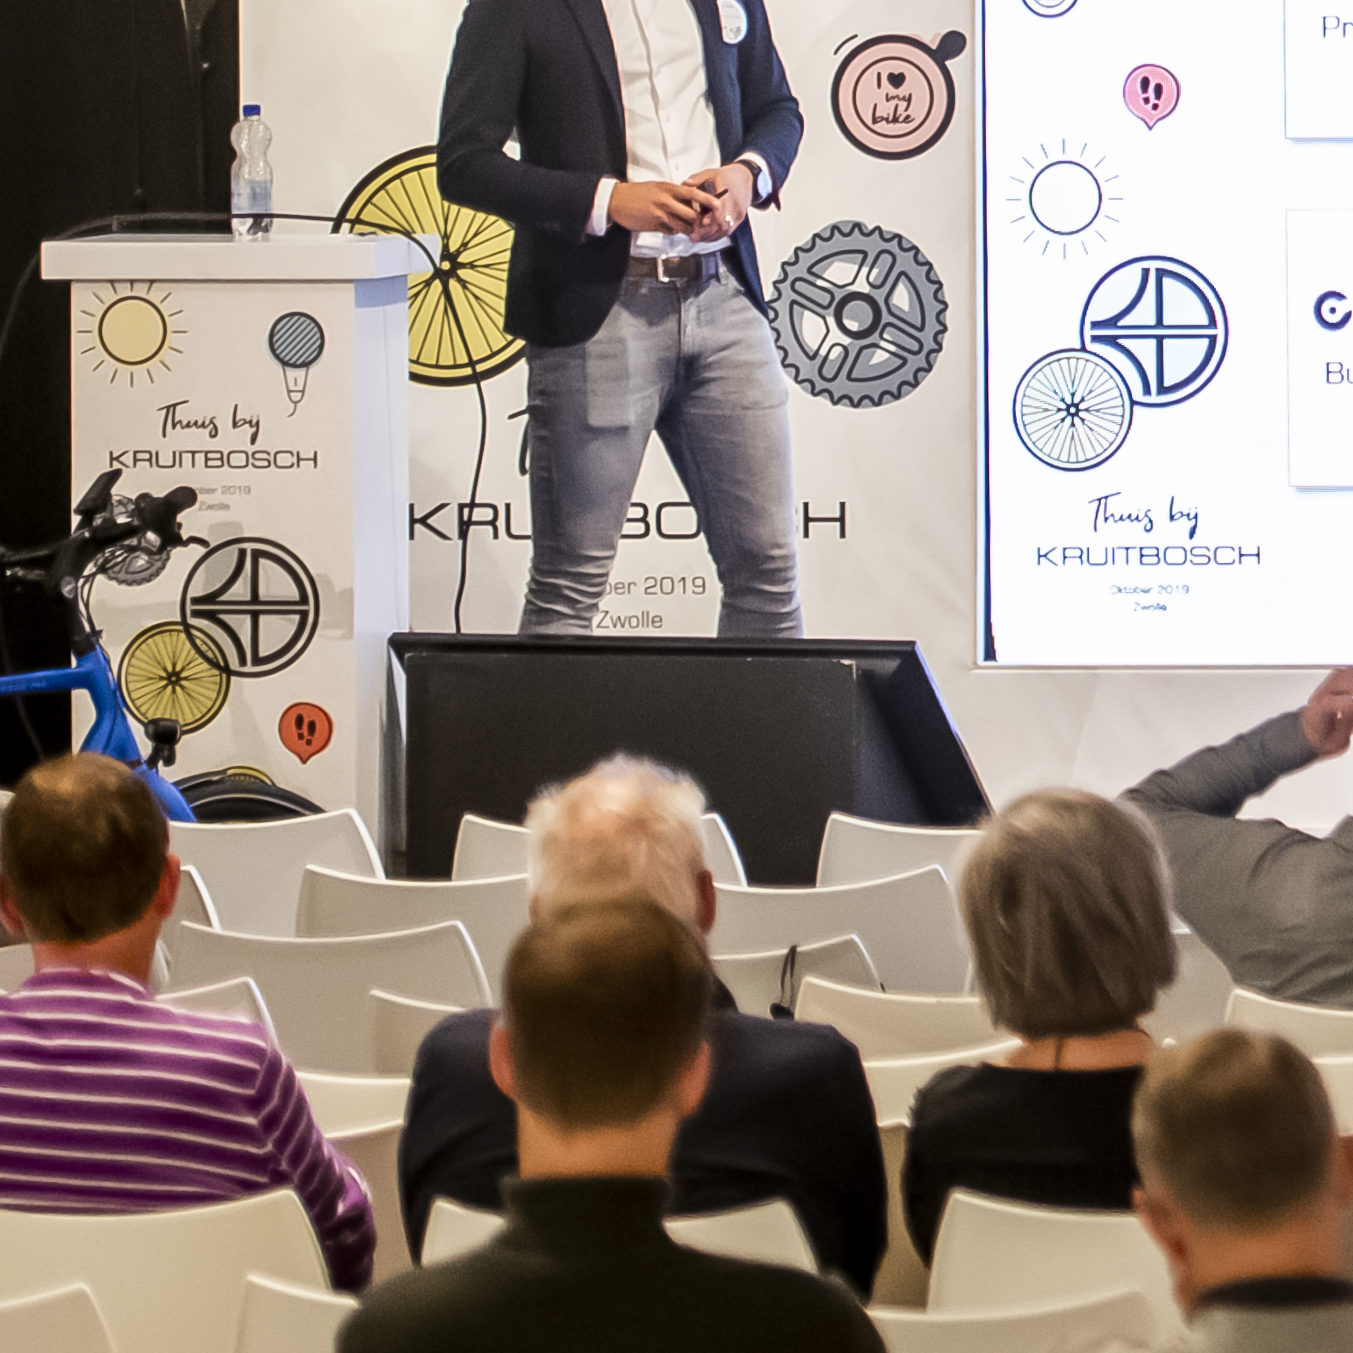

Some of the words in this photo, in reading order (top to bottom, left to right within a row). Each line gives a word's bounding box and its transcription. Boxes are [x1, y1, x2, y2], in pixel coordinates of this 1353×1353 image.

[876, 71, 882, 90] I
[885, 92, 912, 112] my
[872, 103, 915, 125] bike
[157, 399, 218, 439] Thuis
[232, 403, 260, 446] bij
[108, 450, 318, 469] KRUITBOSCH
[408, 501, 847, 540] KRUBOH
[1088, 492, 1153, 533] Thuis
[1169, 496, 1199, 540] bij
[1037, 546, 1261, 566] KRUITBOSCH
[644, 576, 706, 595] 2019
[1158, 584, 1190, 595] 2019
[596, 610, 663, 629] Zwolle
